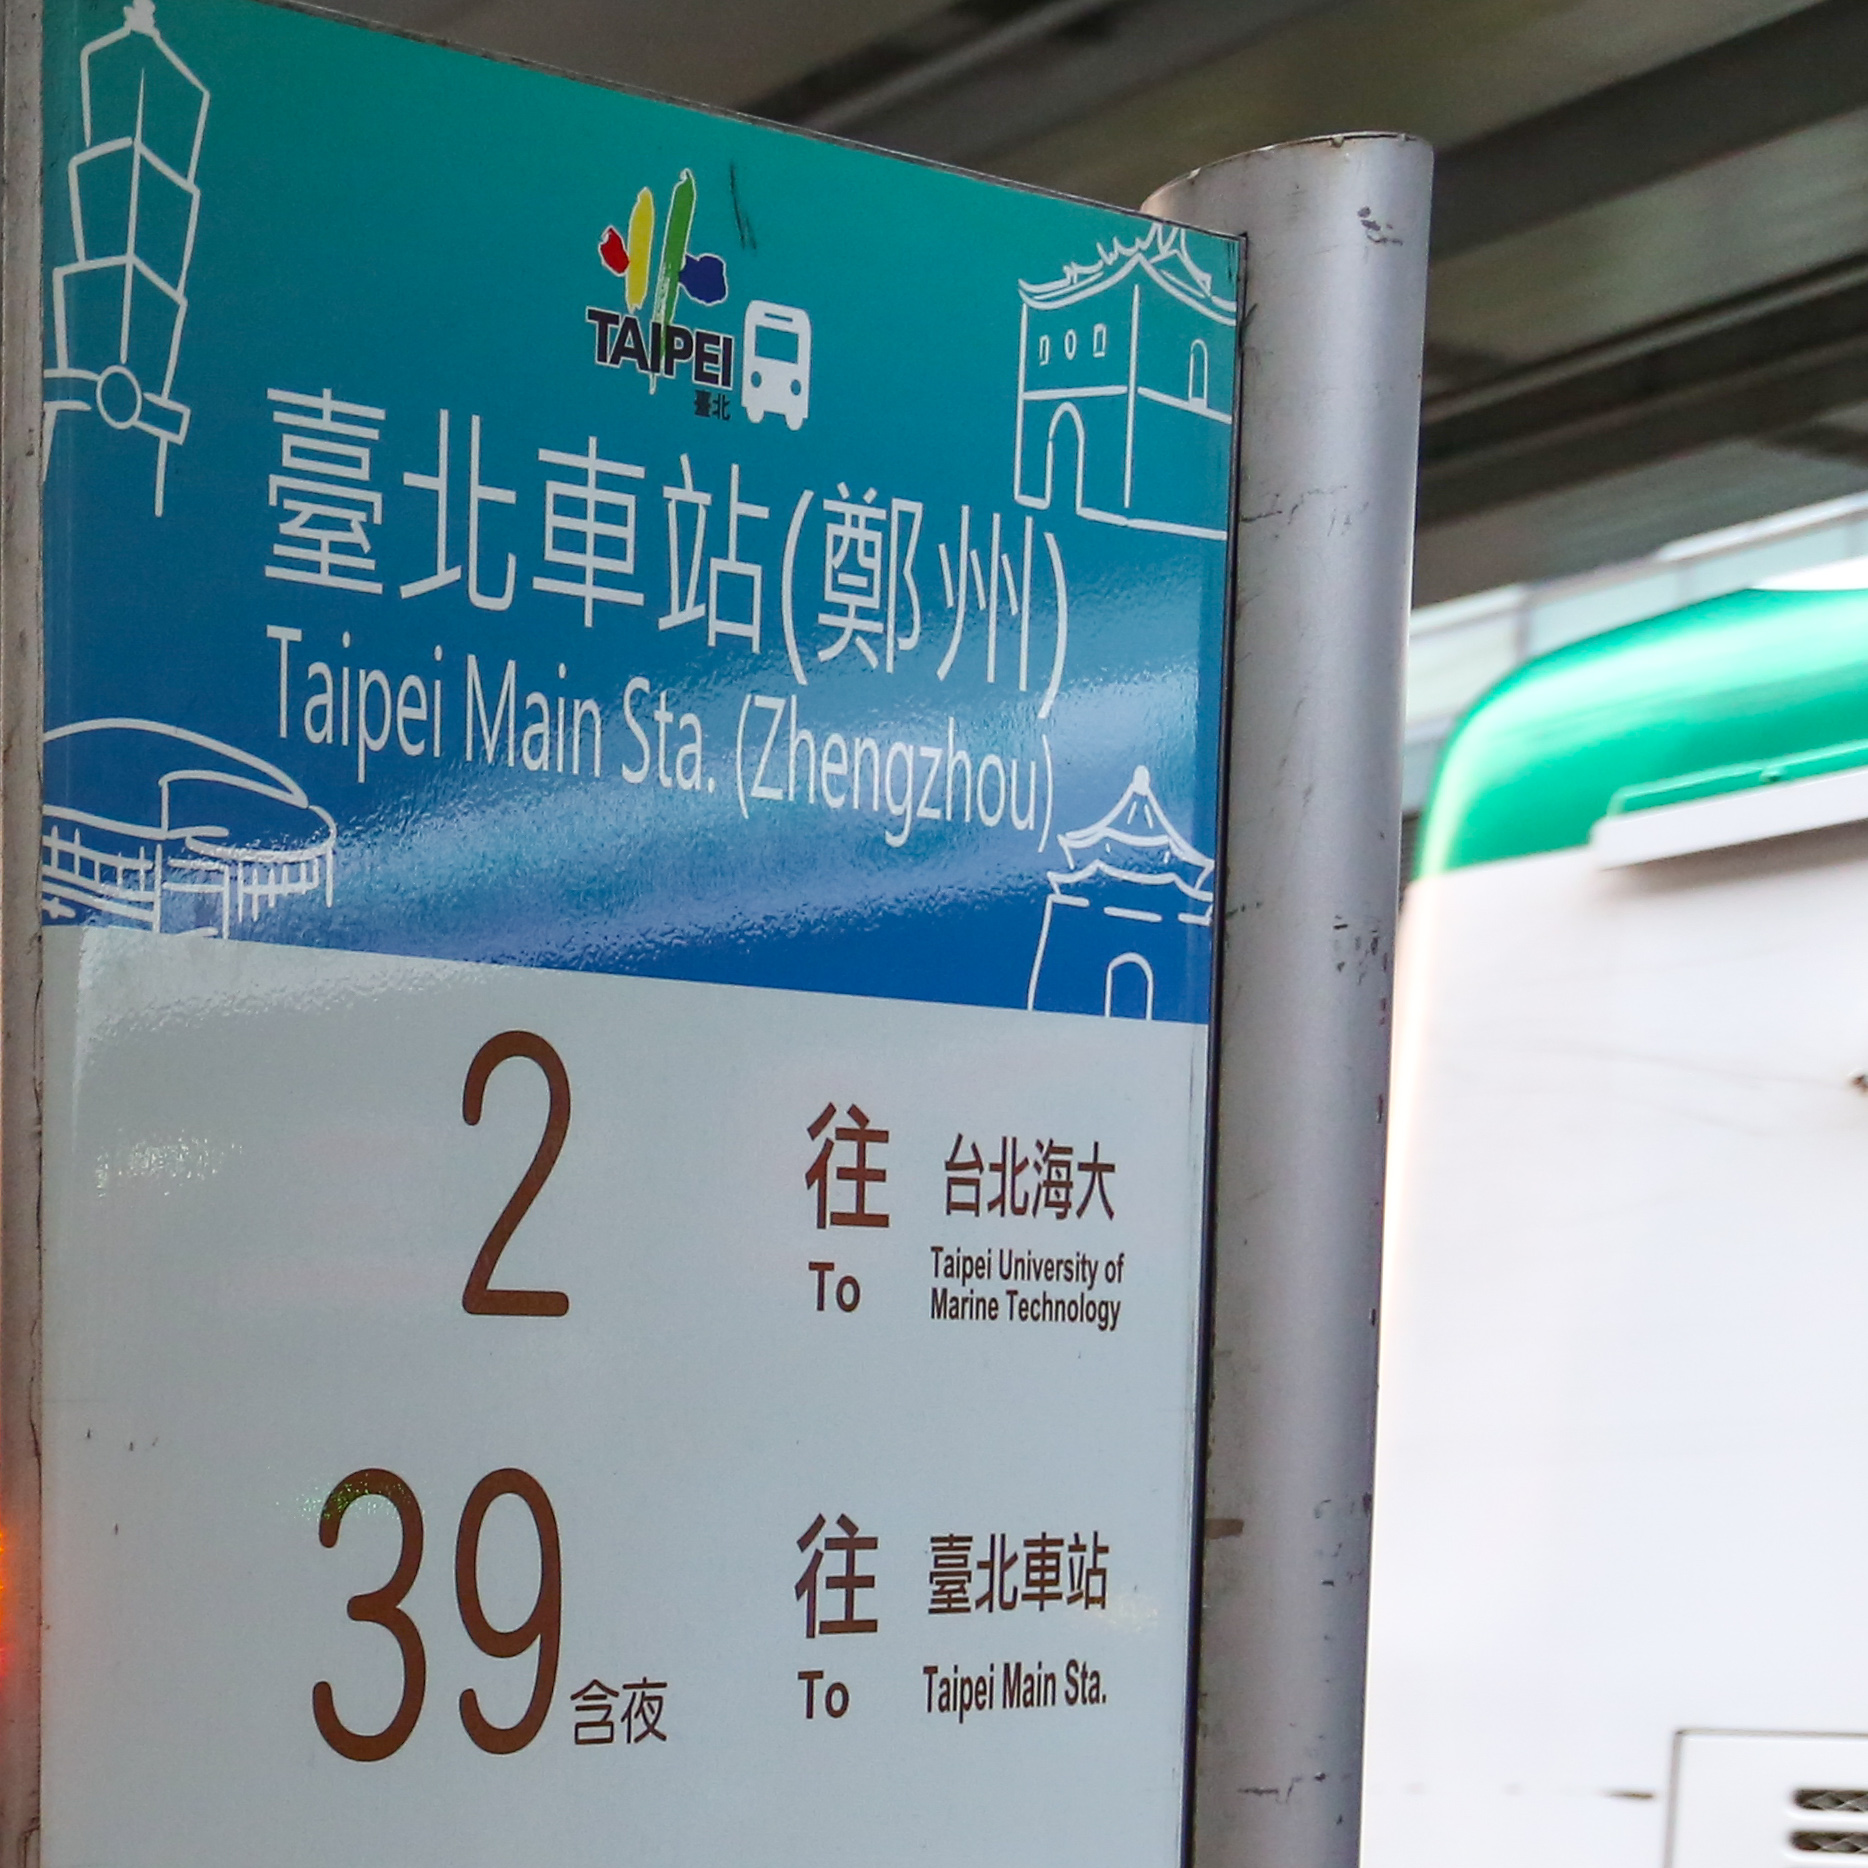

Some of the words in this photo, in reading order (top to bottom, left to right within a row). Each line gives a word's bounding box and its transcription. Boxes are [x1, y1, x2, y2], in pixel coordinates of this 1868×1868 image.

[586, 307, 734, 390] TAIPEI
[263, 386, 1069, 720] 臺北車站(鄭州)
[265, 625, 443, 785] Taipei
[466, 653, 602, 778] Main
[622, 676, 717, 793] Sta.
[736, 692, 1055, 852] (Zhengzhou)
[462, 1030, 571, 1317] 2
[805, 1102, 890, 1230] 往
[944, 1133, 1116, 1222] 台北海大
[808, 1261, 861, 1313] To
[931, 1246, 992, 1287] Taipei
[999, 1249, 1098, 1291] University
[1105, 1252, 1125, 1284] of
[931, 1286, 1000, 1322] Marine
[1005, 1290, 1122, 1331] Technology
[312, 1468, 563, 1762] 39
[570, 1677, 668, 1746] 含夜
[795, 1513, 879, 1640] 往
[928, 1531, 1109, 1615] 臺北車站
[798, 1670, 850, 1720] To
[923, 1664, 995, 1720] Taipei
[1002, 1661, 1058, 1710] Main
[1065, 1658, 1107, 1707] Sta.
